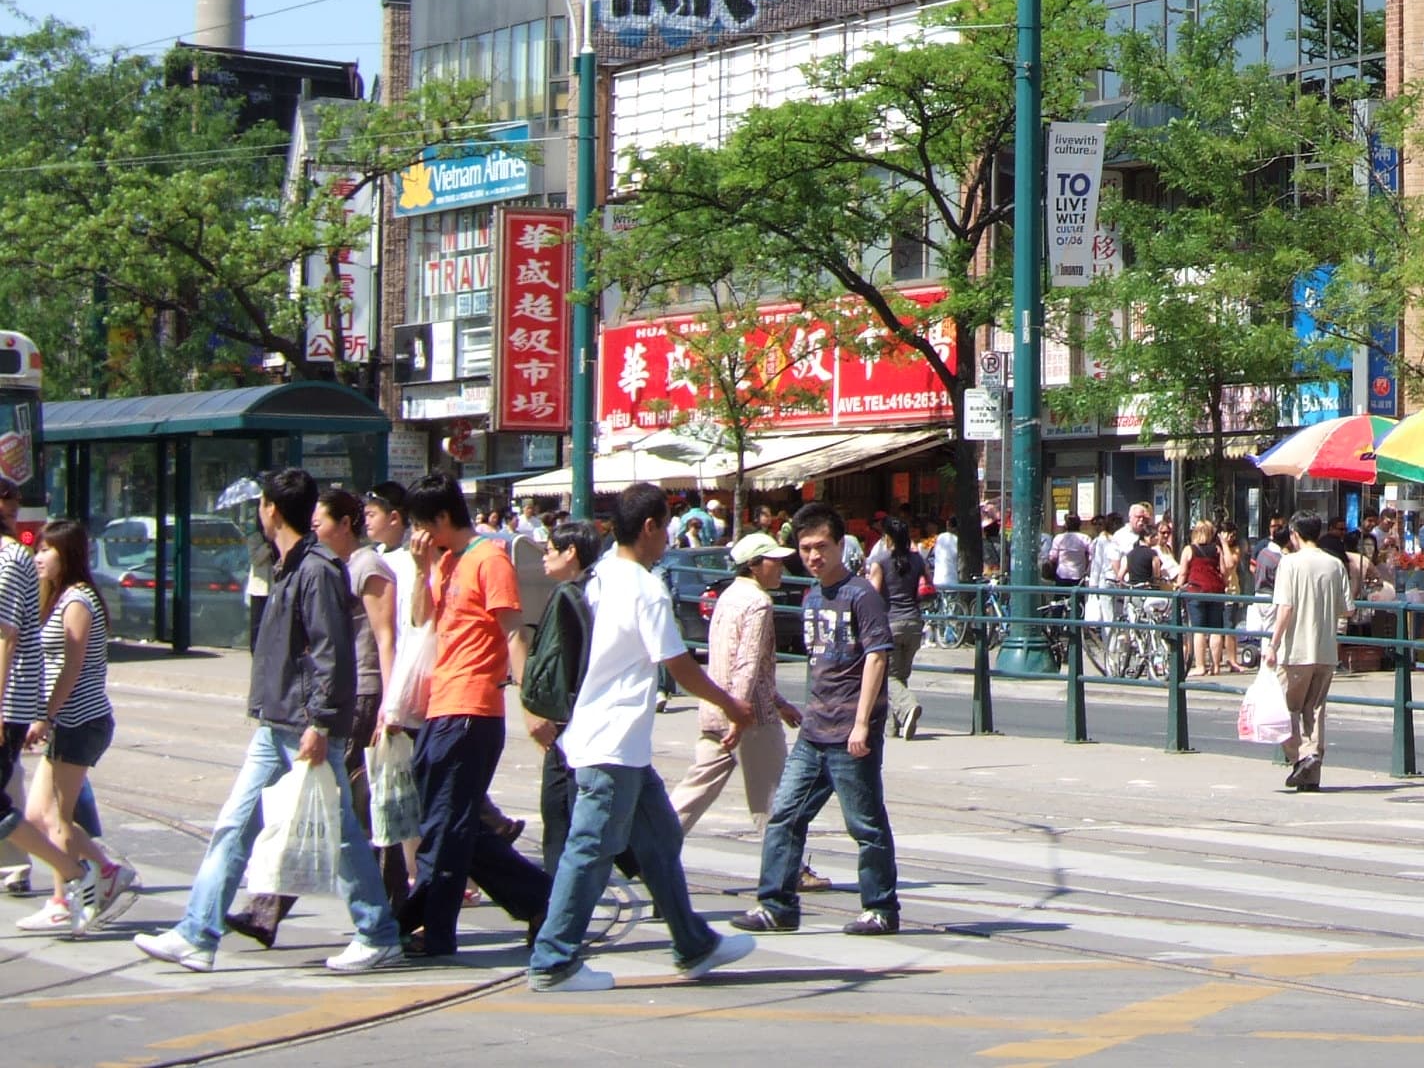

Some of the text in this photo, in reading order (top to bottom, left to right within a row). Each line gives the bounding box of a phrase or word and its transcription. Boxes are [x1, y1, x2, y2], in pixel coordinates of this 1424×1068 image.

[1055, 134, 1098, 146] livewith
[432, 153, 527, 192] Vietnam Airlines
[1056, 173, 1091, 197] TO
[1056, 197, 1087, 212] LIVE
[1056, 213, 1086, 225] WITH
[509, 223, 560, 419] 華盛超級市場
